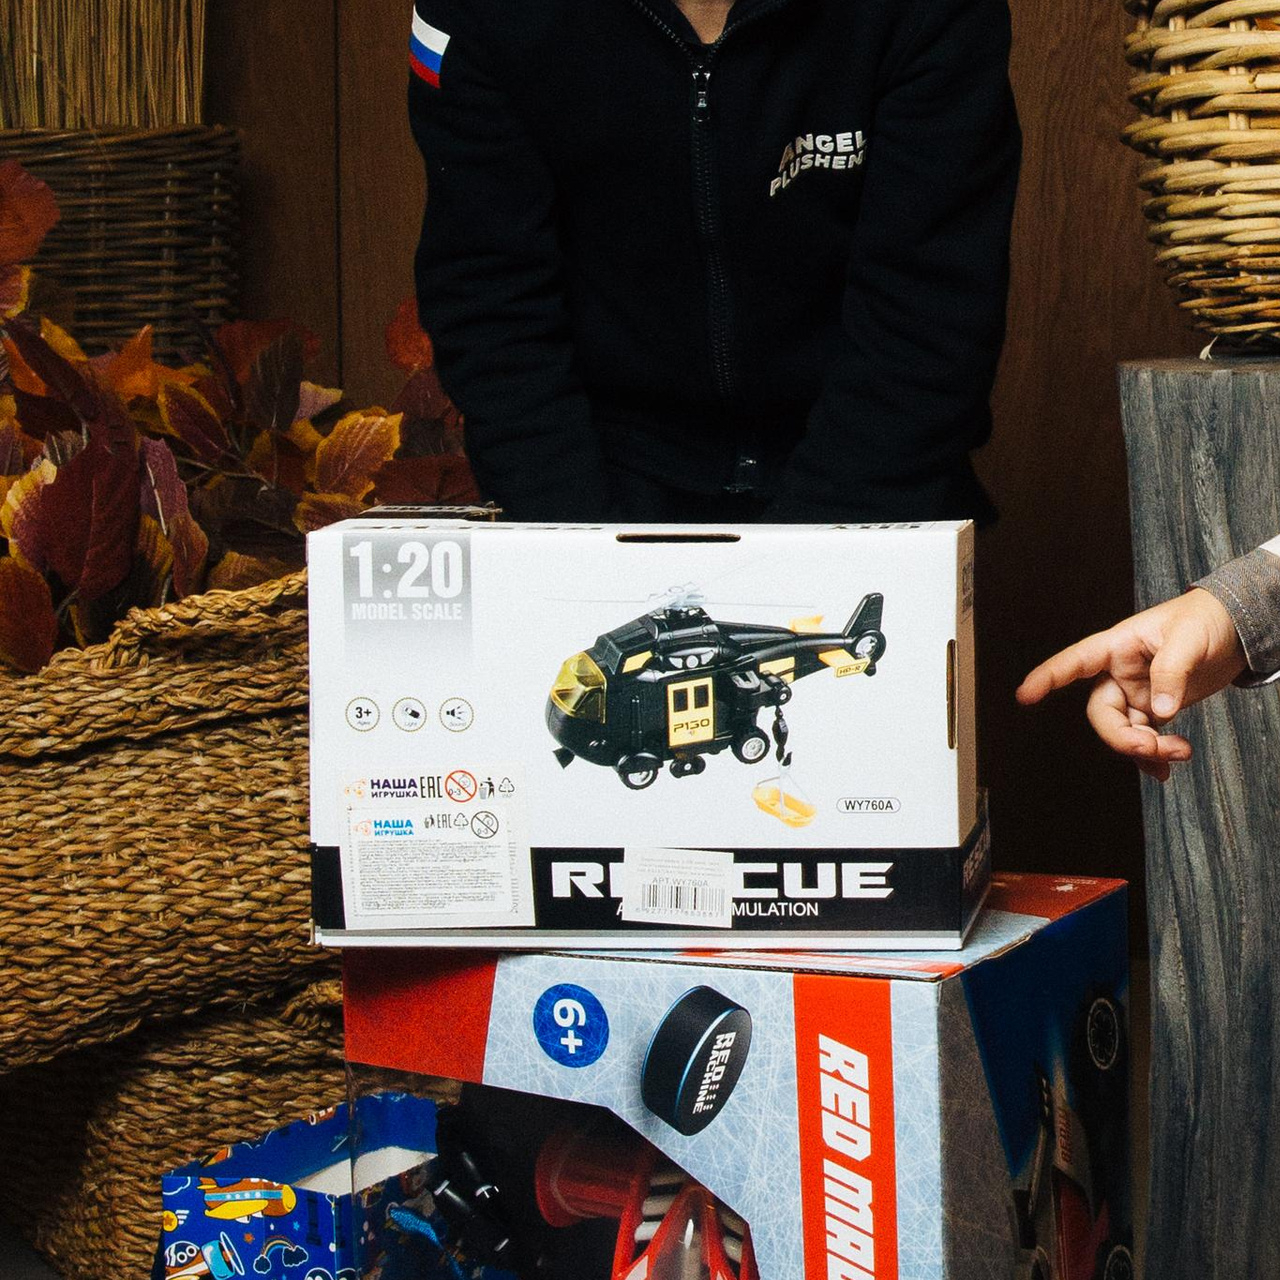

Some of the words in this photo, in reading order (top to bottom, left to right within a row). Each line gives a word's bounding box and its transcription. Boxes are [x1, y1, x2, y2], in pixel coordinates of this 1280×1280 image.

[779, 131, 867, 173] ANGEL
[769, 150, 867, 196] PLUSHEN
[350, 541, 463, 599] 1:20
[352, 603, 407, 620] MODEL
[411, 603, 462, 620] SCALE
[355, 706, 372, 719] 3+
[370, 778, 418, 789] НАША
[371, 790, 418, 798] ИГРУШКА
[373, 819, 414, 829] НАША
[844, 800, 894, 811] WY760A
[551, 862, 894, 899] RCUE
[731, 902, 819, 917] MULATION
[553, 998, 586, 1054] 6+
[692, 1033, 726, 1114] MACHINE
[711, 1031, 736, 1083] RED
[819, 1032, 872, 1161] RED
